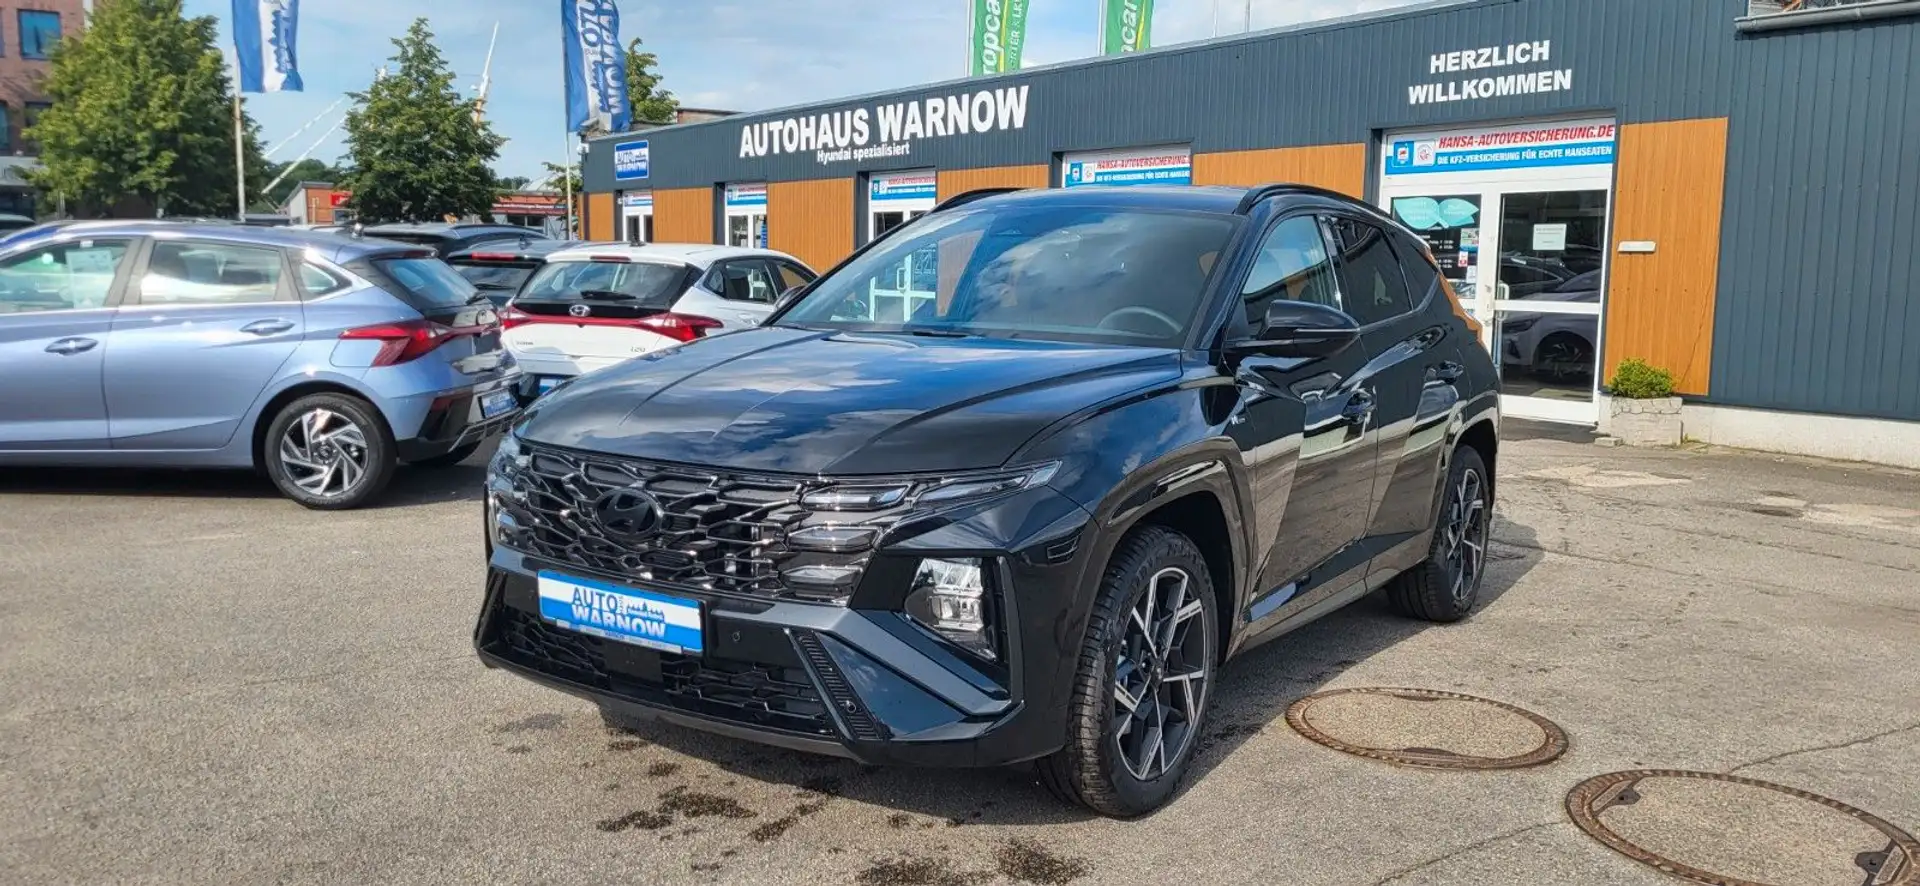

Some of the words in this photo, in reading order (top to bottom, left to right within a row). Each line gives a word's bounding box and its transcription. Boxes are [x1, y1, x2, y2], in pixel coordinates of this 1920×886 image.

[1430, 40, 1550, 74] HERZLICH
[1408, 69, 1572, 105] WILLKOMMEN
[739, 107, 869, 158] AUTOHAUS
[876, 85, 1030, 143] WARNOW
[1438, 124, 1616, 149] HANSA-AUTOVERSICHERUNG.DE
[816, 148, 851, 165] Hyundai
[853, 141, 910, 162] spezialisiert
[1437, 155, 1449, 165] DIE
[1449, 151, 1520, 165] KFZ-VERSICHERUNG
[1521, 149, 1537, 160] FÜR
[572, 587, 618, 613] AUTO
[571, 604, 666, 639] WARNOW
